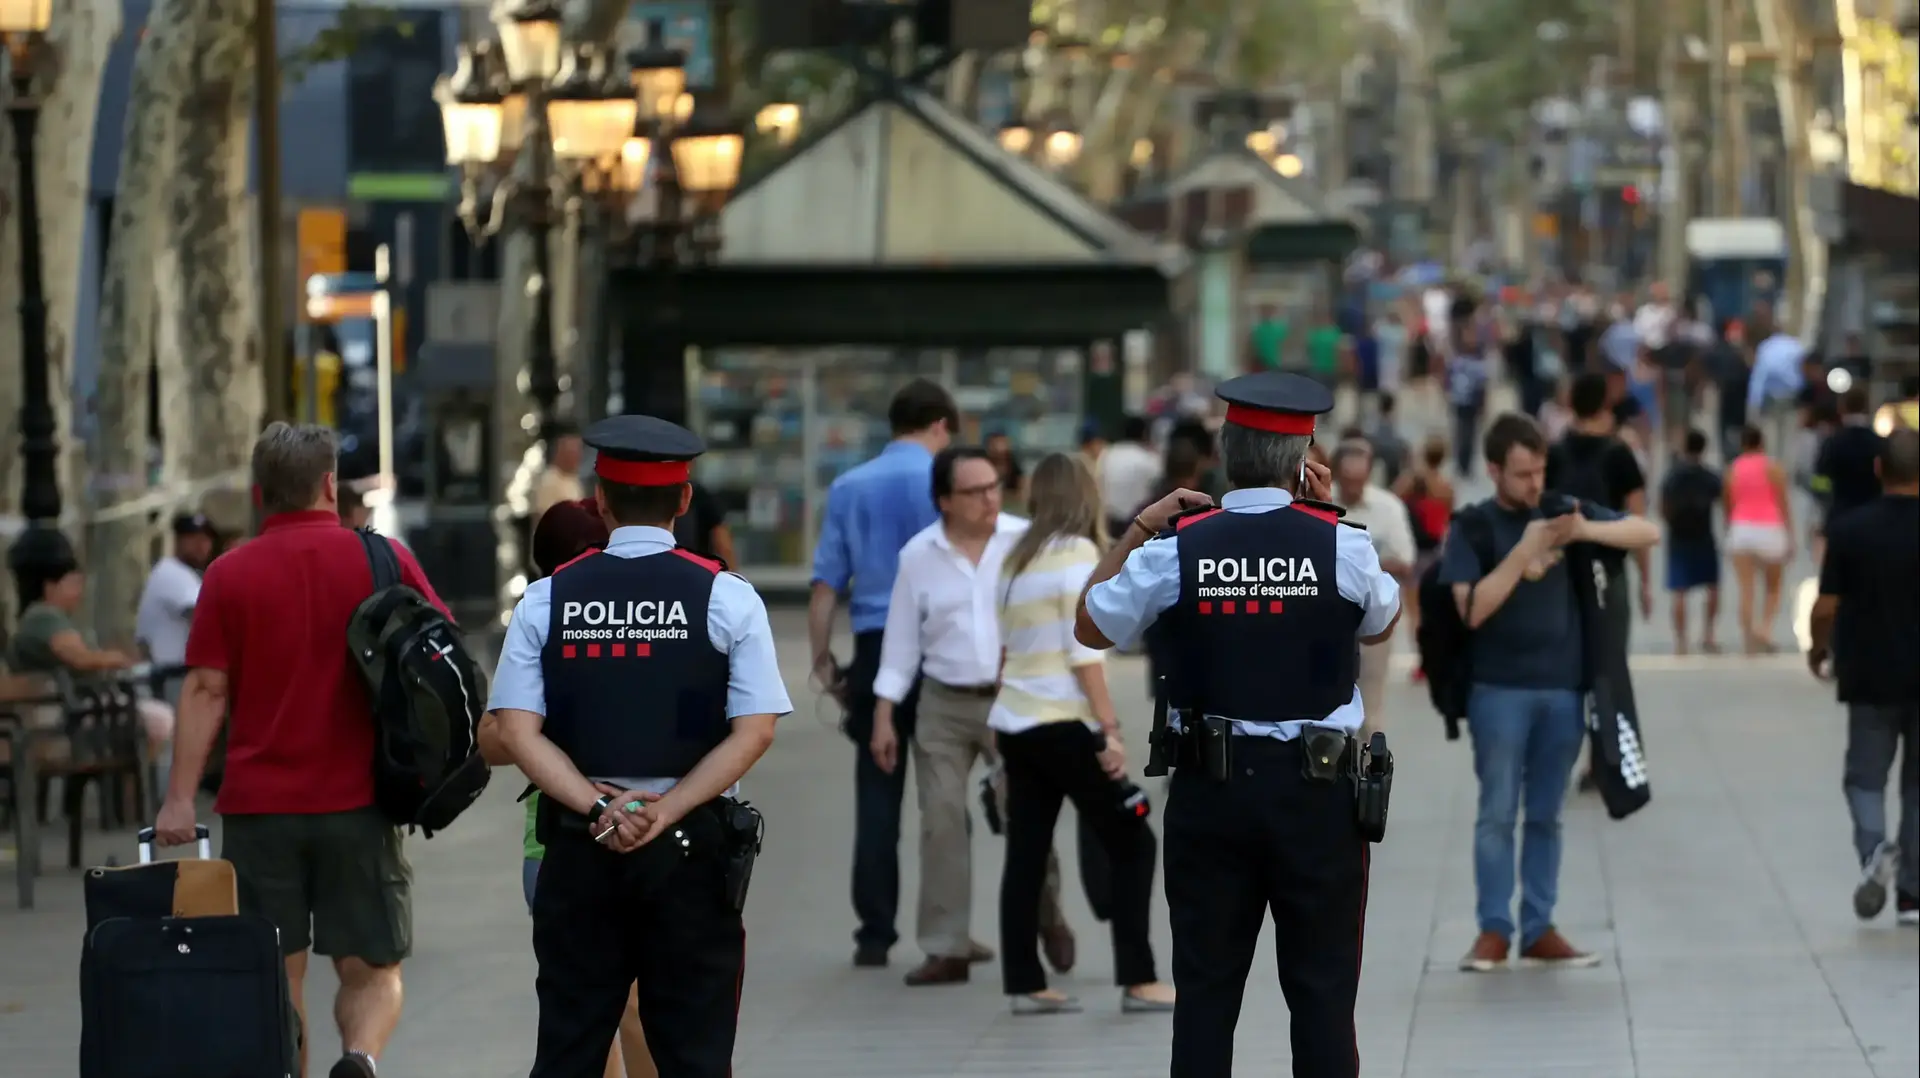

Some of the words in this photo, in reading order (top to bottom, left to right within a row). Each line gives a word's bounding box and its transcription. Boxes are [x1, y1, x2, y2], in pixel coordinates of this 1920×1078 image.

[1198, 558, 1318, 583] POLICIA
[1198, 586, 1247, 597] mossos
[563, 601, 688, 625] POLICIA
[563, 628, 613, 640] mossos
